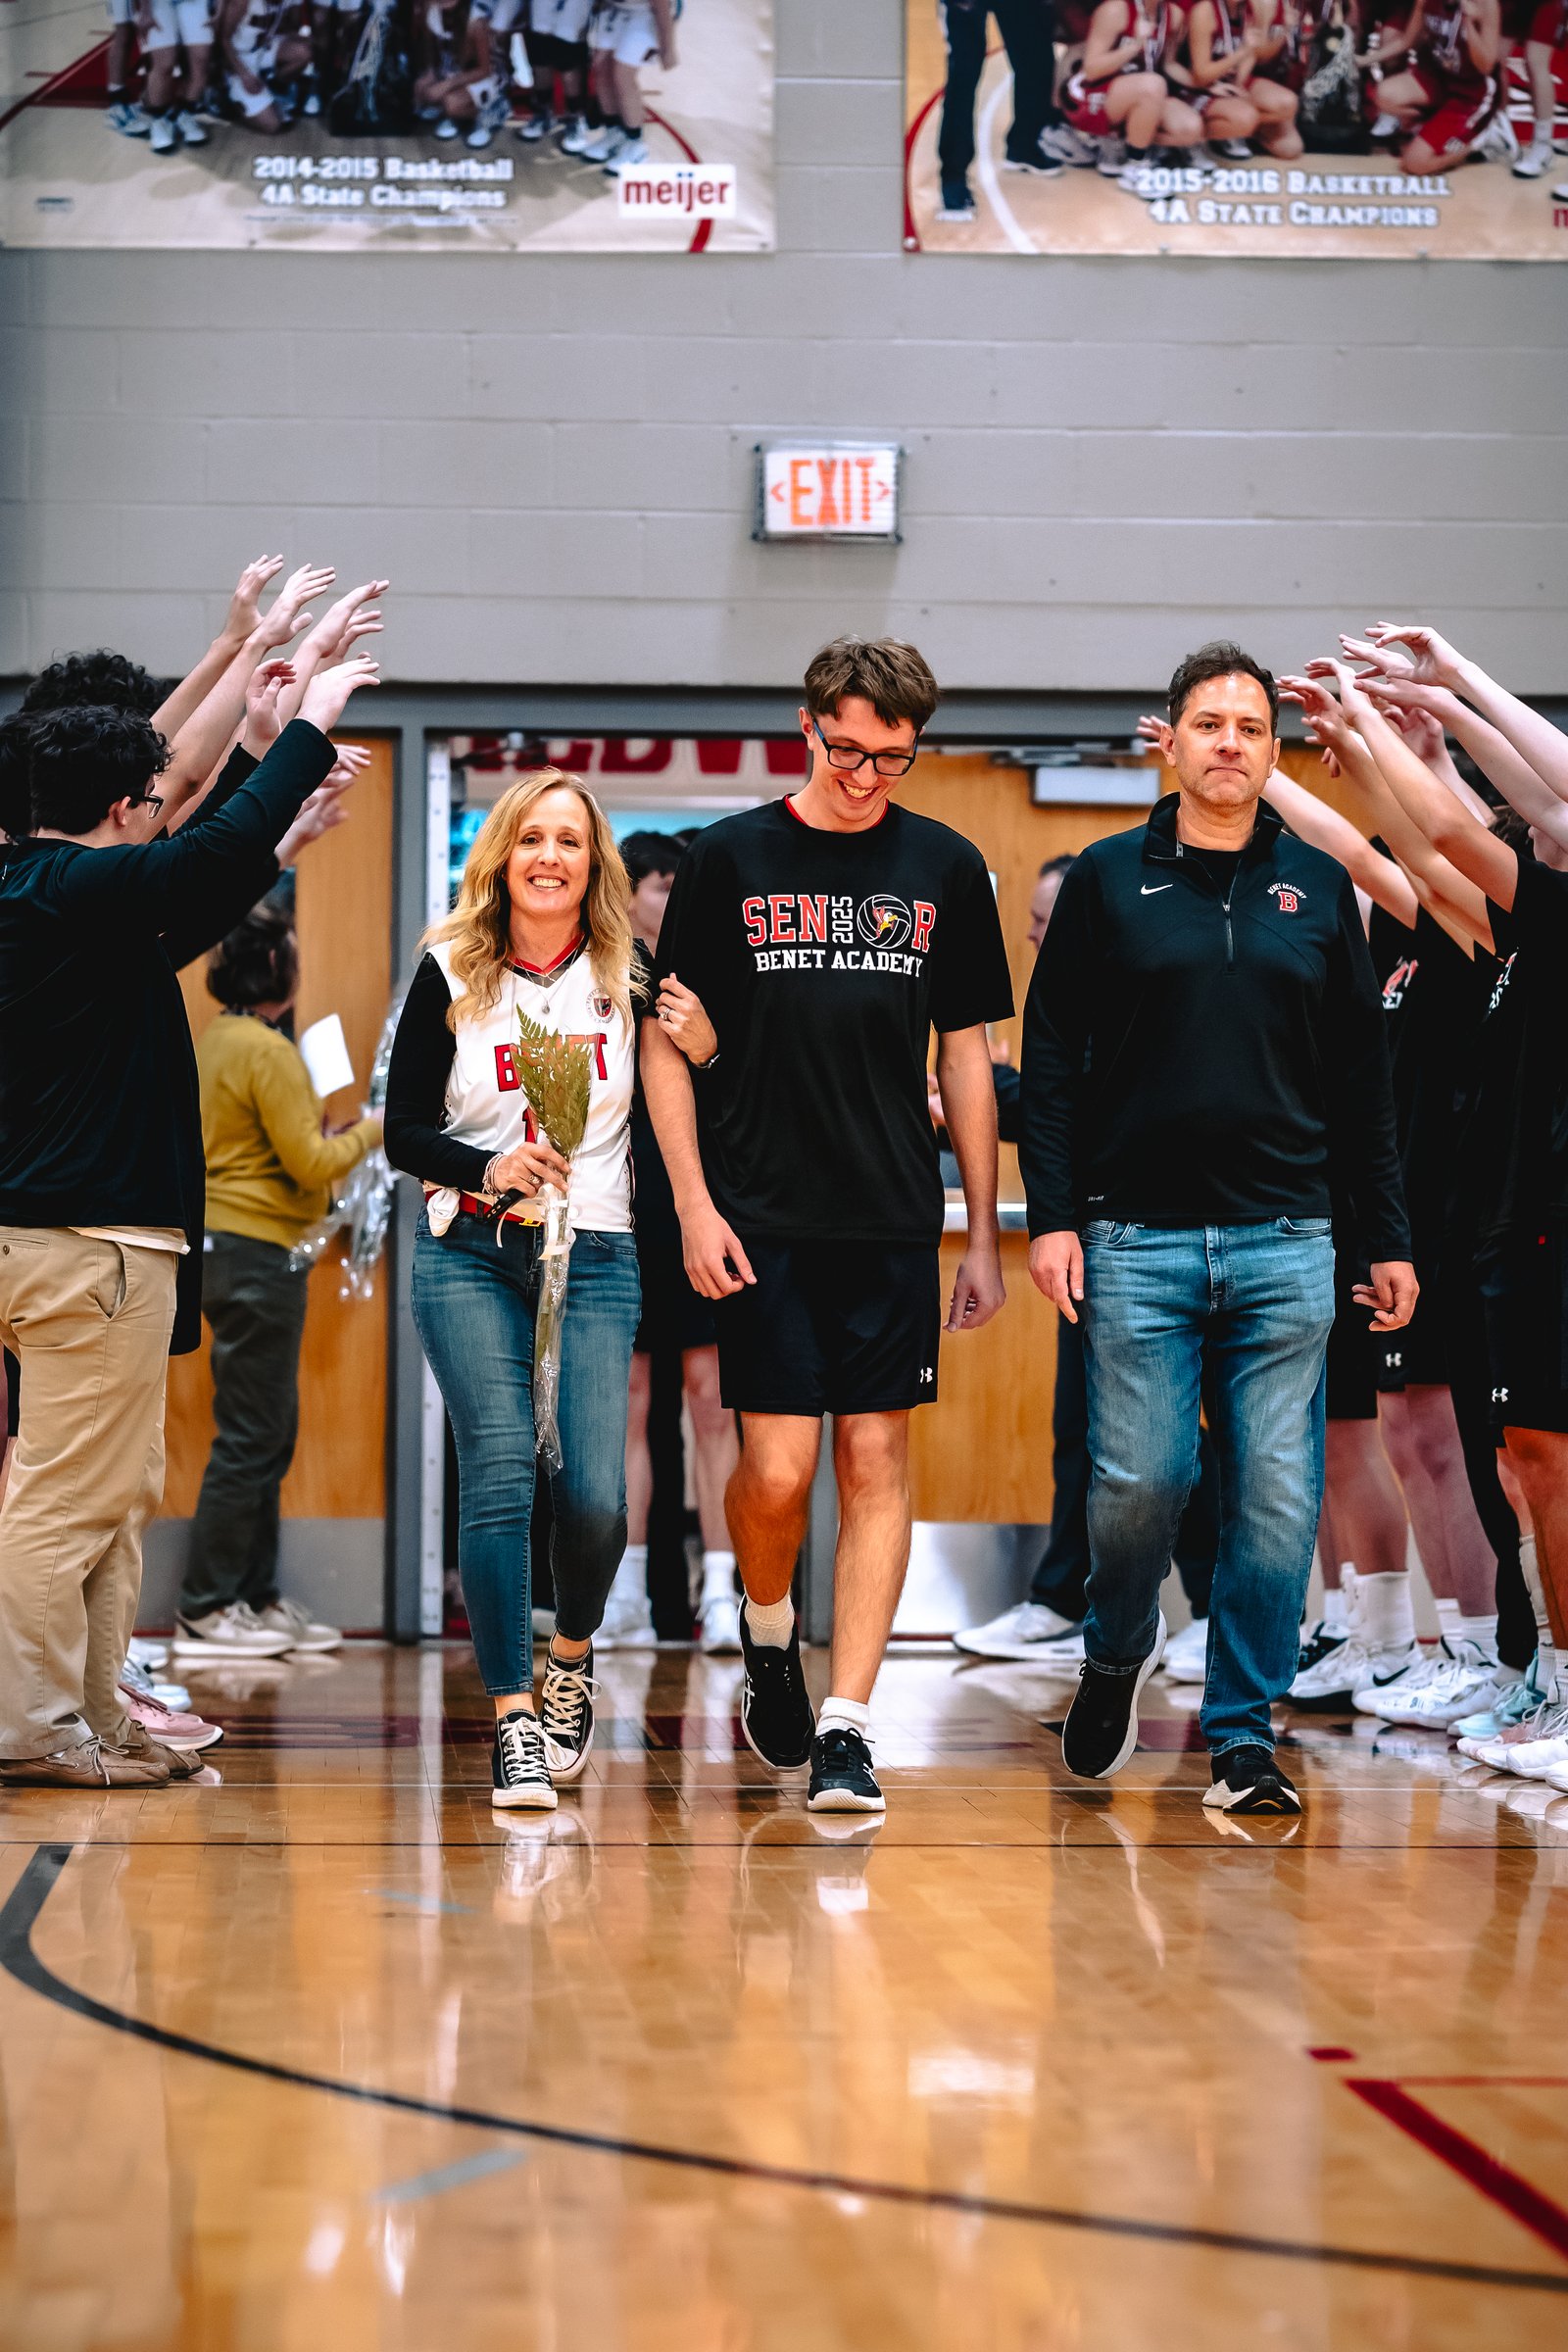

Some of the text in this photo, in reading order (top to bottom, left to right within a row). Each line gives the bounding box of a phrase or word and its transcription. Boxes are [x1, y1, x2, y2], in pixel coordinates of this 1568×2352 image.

[253, 157, 514, 180] 2014-2015 Basketball
[1137, 169, 1450, 195] 2015-2016 BASKETBALL
[261, 183, 507, 211] 4A State Champions
[624, 172, 730, 213] meijer
[1149, 199, 1191, 222] 4A
[1289, 201, 1440, 226] CHAMPIONS
[789, 457, 876, 526] EXIT
[1278, 891, 1298, 912] B
[1282, 882, 1307, 899] ACADEMY
[755, 949, 923, 978] BENET ACADEMY
